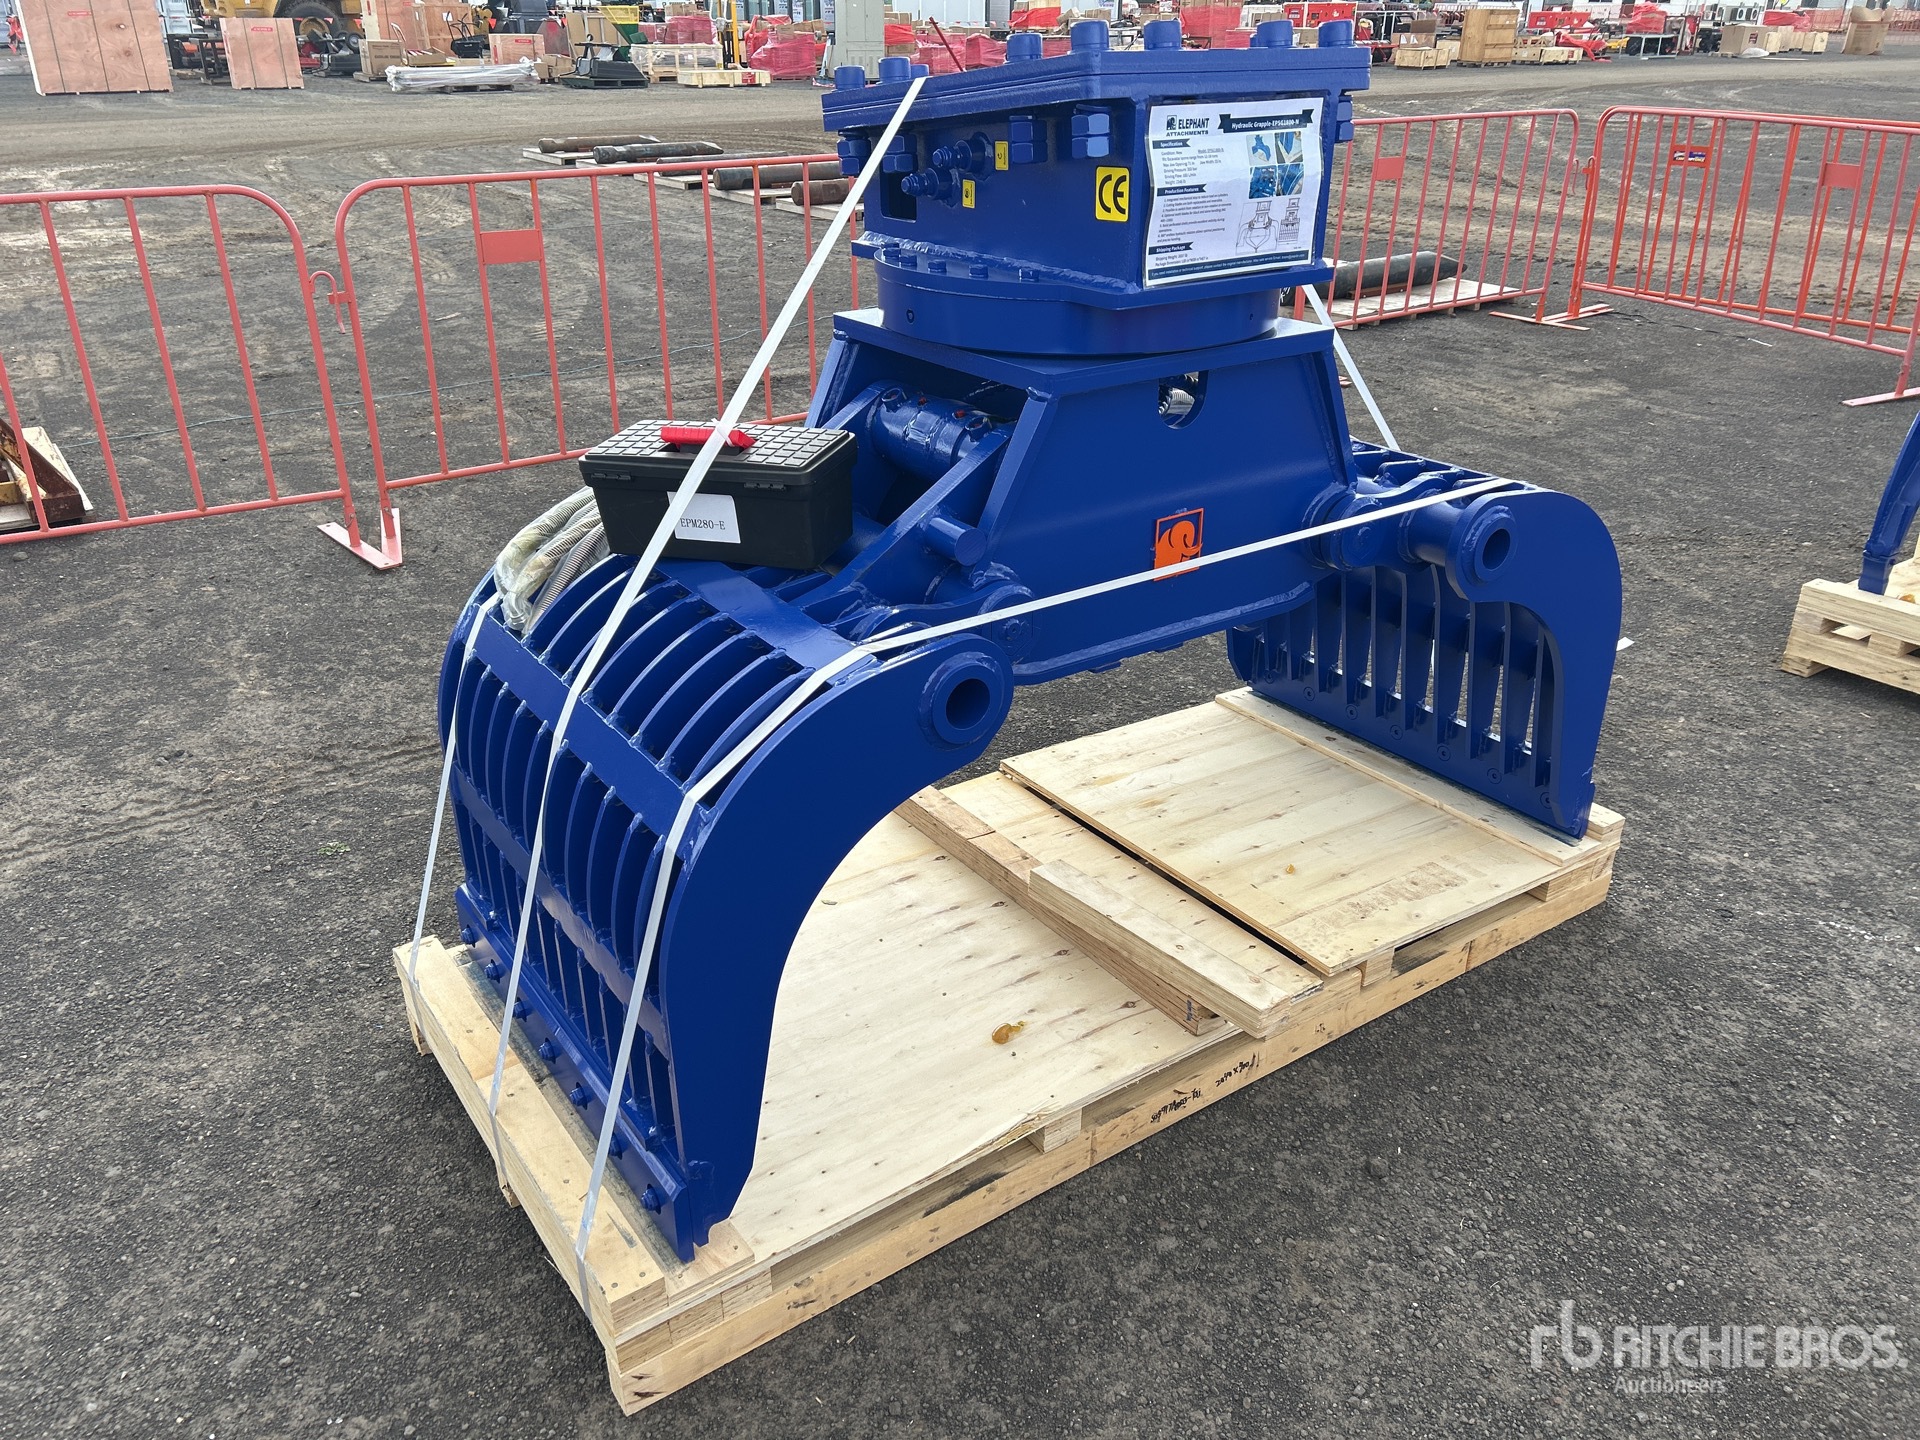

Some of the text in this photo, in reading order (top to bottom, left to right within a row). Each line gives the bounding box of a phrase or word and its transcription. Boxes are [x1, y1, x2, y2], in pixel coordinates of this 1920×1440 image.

[1178, 118, 1210, 129] ELEPHANT
[1231, 122, 1254, 130] Hydraulic
[1098, 174, 1127, 215] CE
[680, 518, 726, 530] EPM280-E
